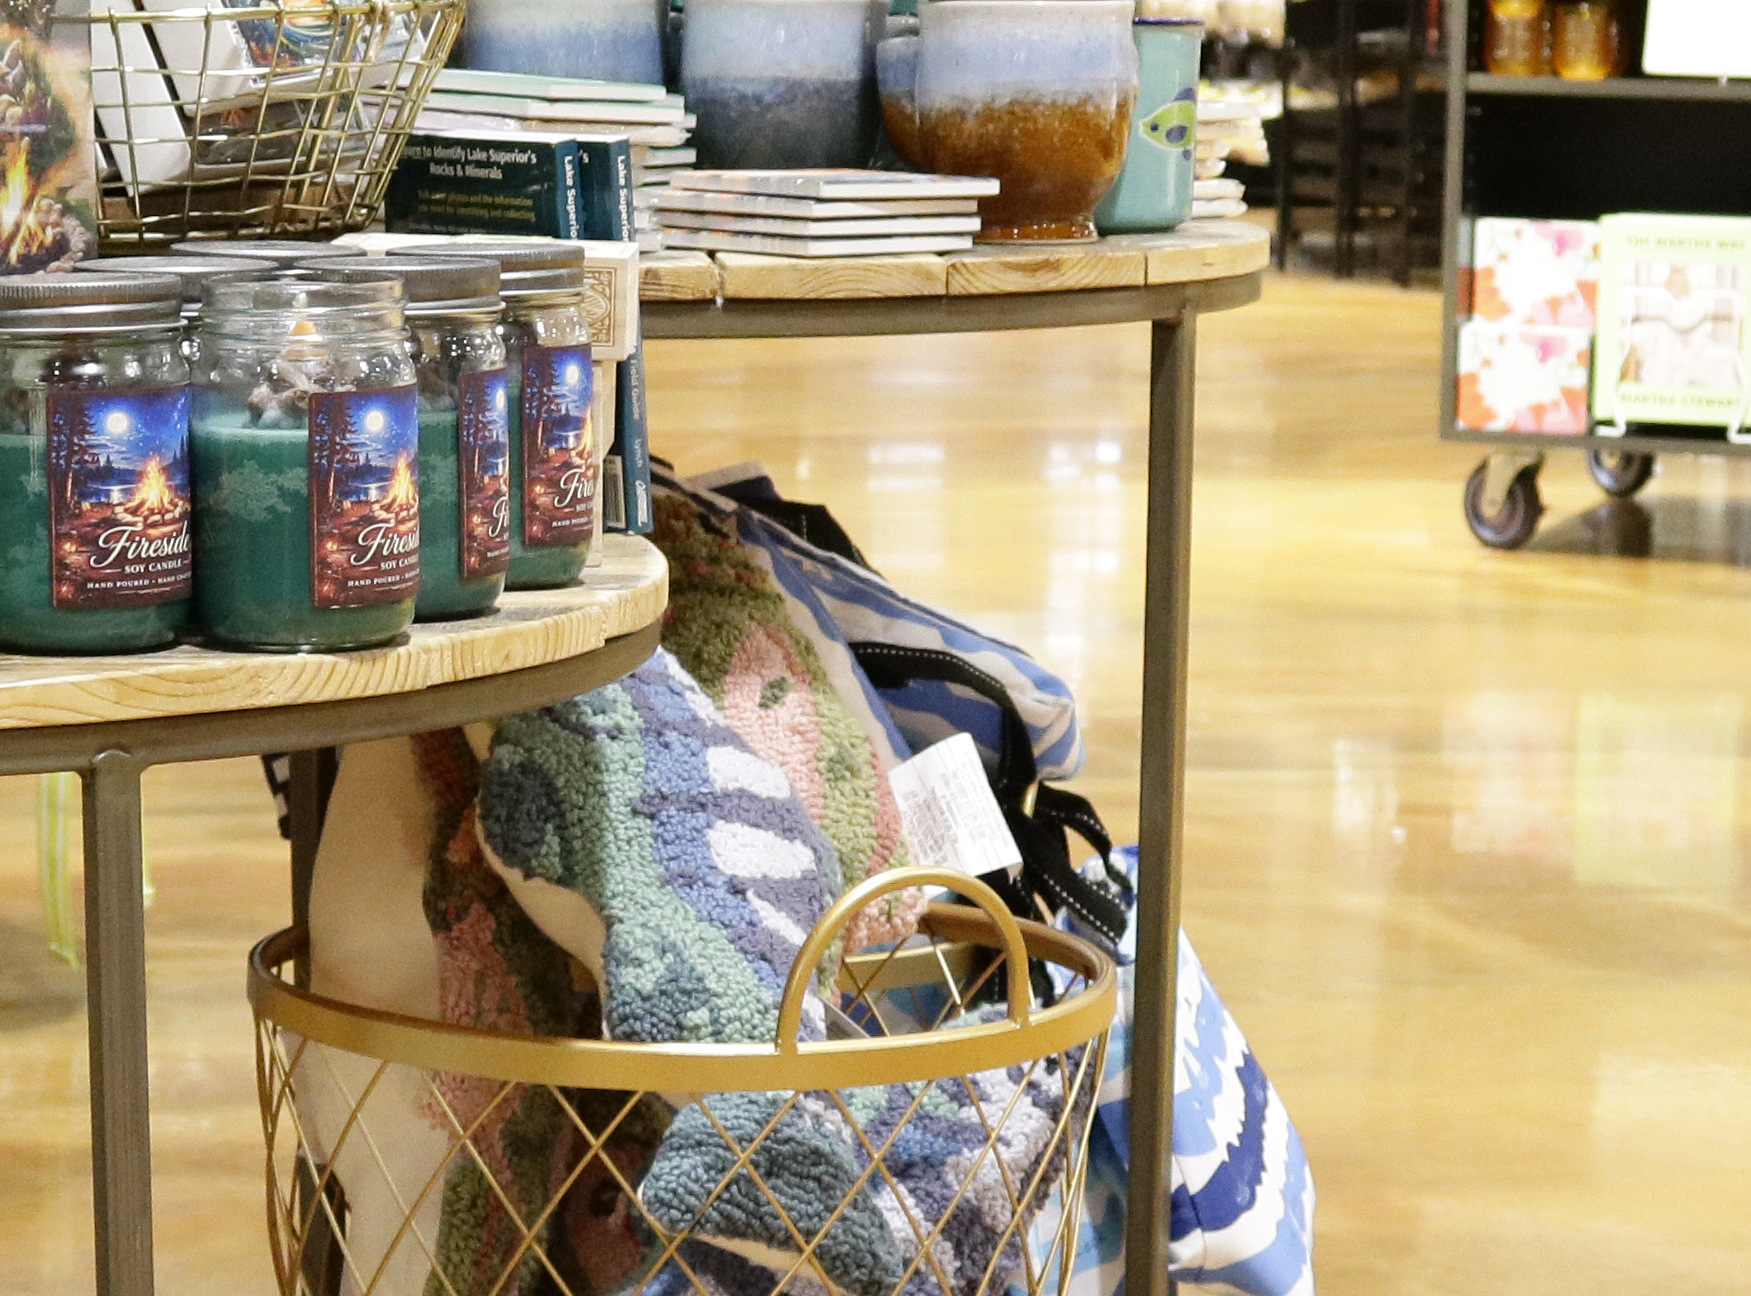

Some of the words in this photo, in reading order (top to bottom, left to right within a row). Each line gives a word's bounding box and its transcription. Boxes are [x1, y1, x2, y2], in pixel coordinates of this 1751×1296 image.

[433, 146, 466, 163] Identify
[467, 149, 488, 162] Lake
[489, 149, 537, 165] Superior's
[564, 155, 576, 186] Lake
[617, 155, 626, 186] Lake
[631, 386, 640, 419] Guide
[124, 563, 146, 575] SOY
[148, 558, 182, 573] CANDLE
[380, 559, 397, 572] SOY
[86, 581, 114, 590] HAND
[116, 578, 150, 588] POURED
[347, 578, 372, 588] HAND
